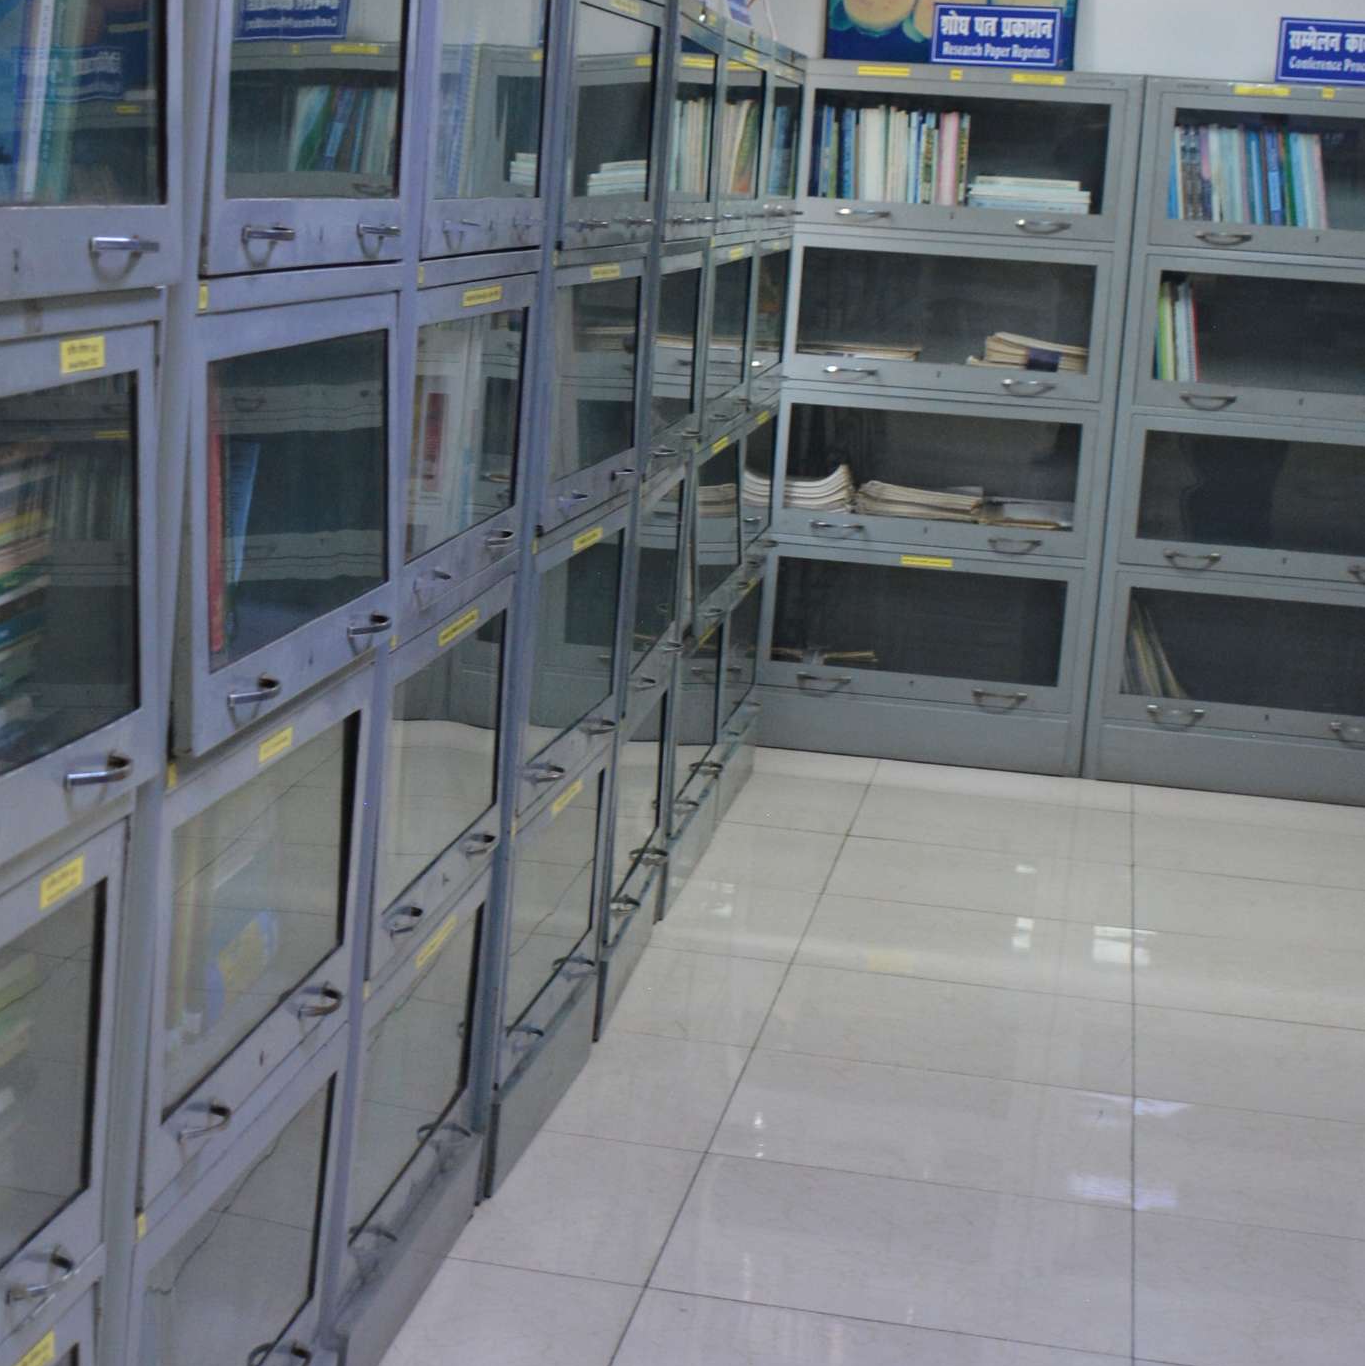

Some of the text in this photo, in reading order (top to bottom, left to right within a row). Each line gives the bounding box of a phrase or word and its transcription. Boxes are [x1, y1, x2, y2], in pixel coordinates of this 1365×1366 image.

[940, 10, 971, 37] शोध
[942, 41, 1051, 61] Research Paper Reprints
[1289, 55, 1343, 71] Conference
